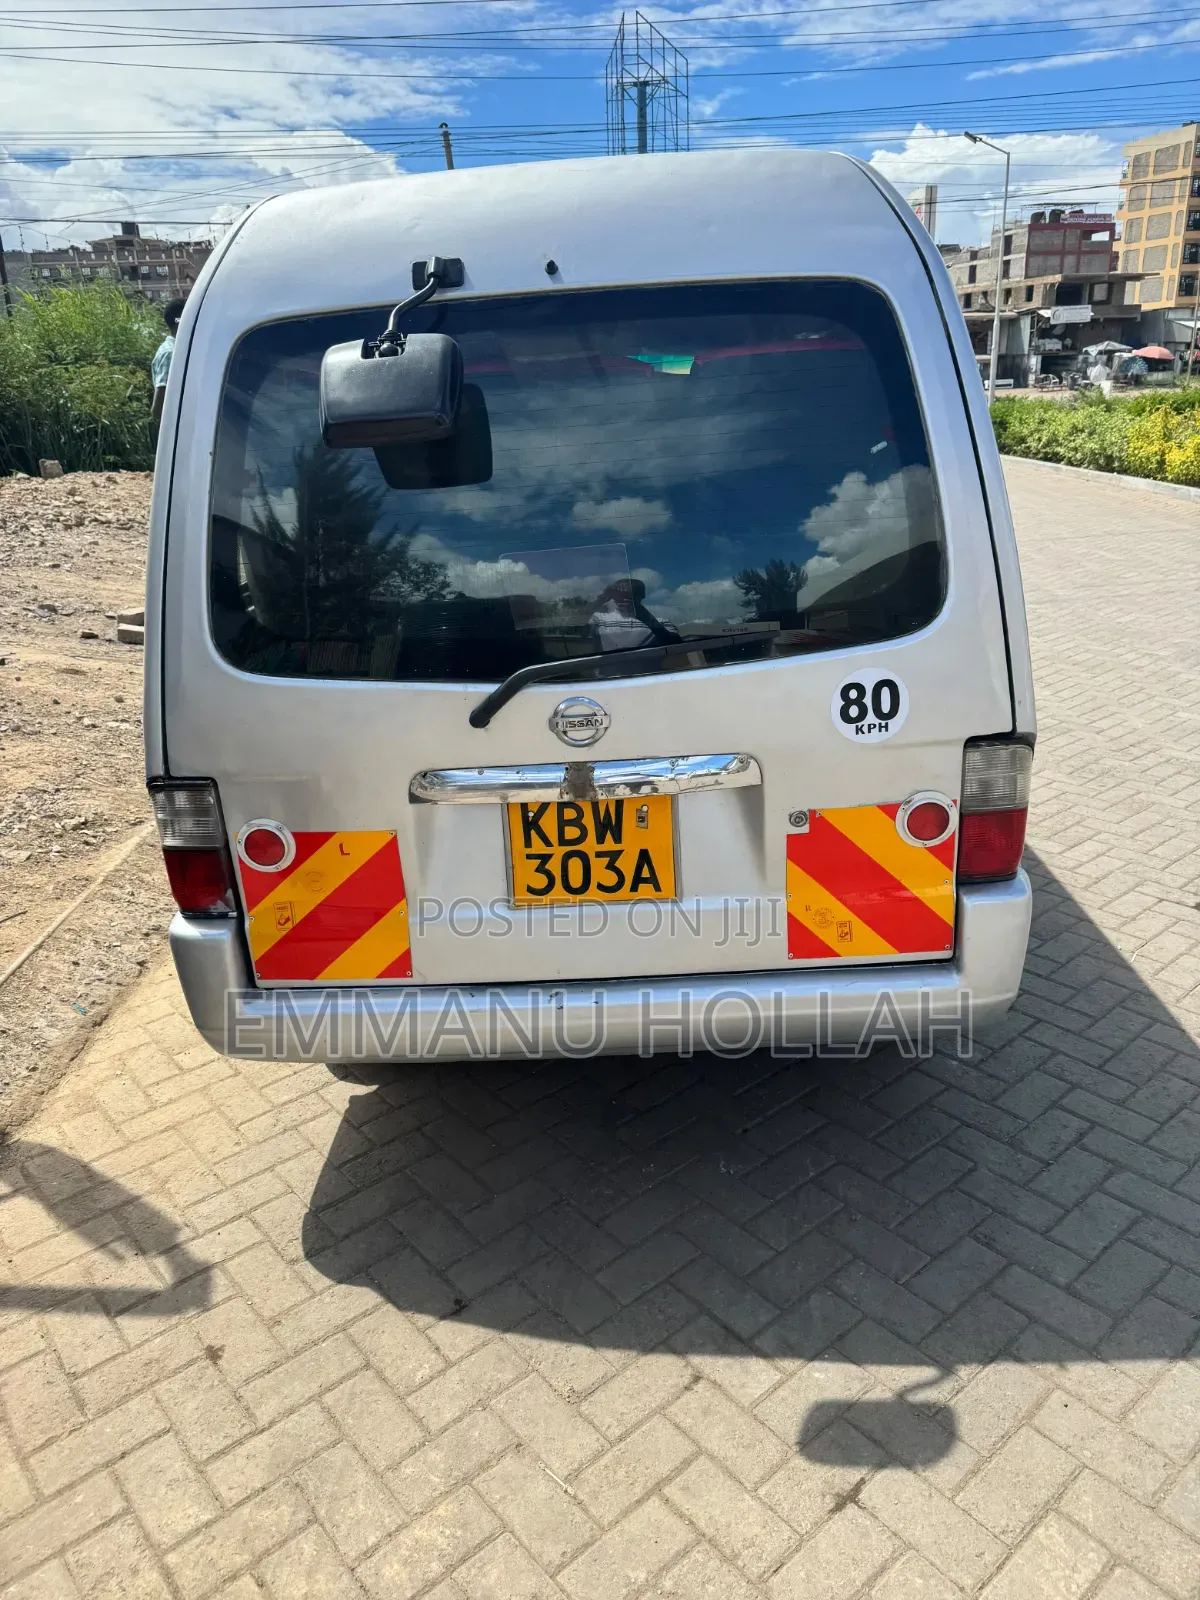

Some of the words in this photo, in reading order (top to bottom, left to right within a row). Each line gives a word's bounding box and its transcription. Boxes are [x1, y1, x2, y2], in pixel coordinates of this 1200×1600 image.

[555, 718, 603, 729] NISSAN
[839, 679, 900, 724] 80
[855, 722, 889, 735] KPH
[520, 800, 624, 848] KBW
[525, 848, 662, 896] 303A
